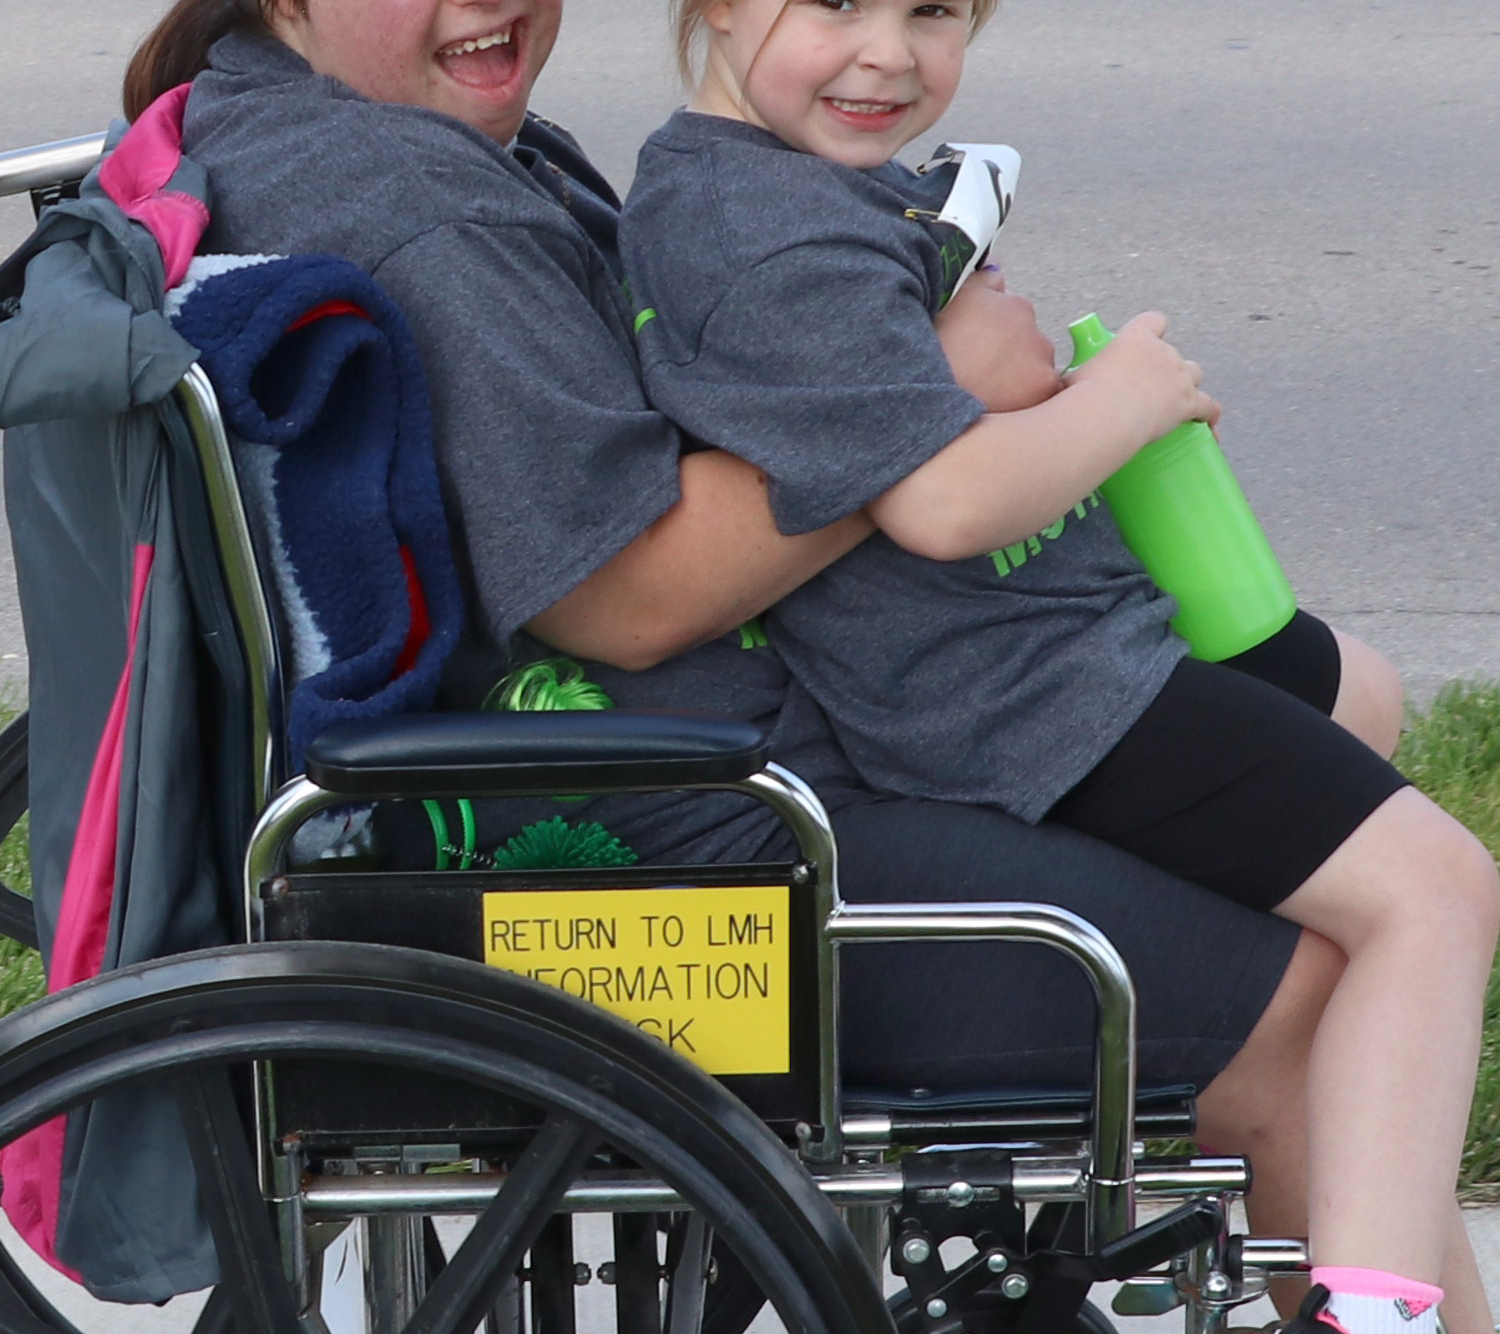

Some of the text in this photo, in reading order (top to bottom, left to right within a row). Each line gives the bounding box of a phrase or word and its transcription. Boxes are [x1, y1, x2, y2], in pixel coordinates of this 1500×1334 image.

[491, 913, 773, 952] RETURN TO LMH
